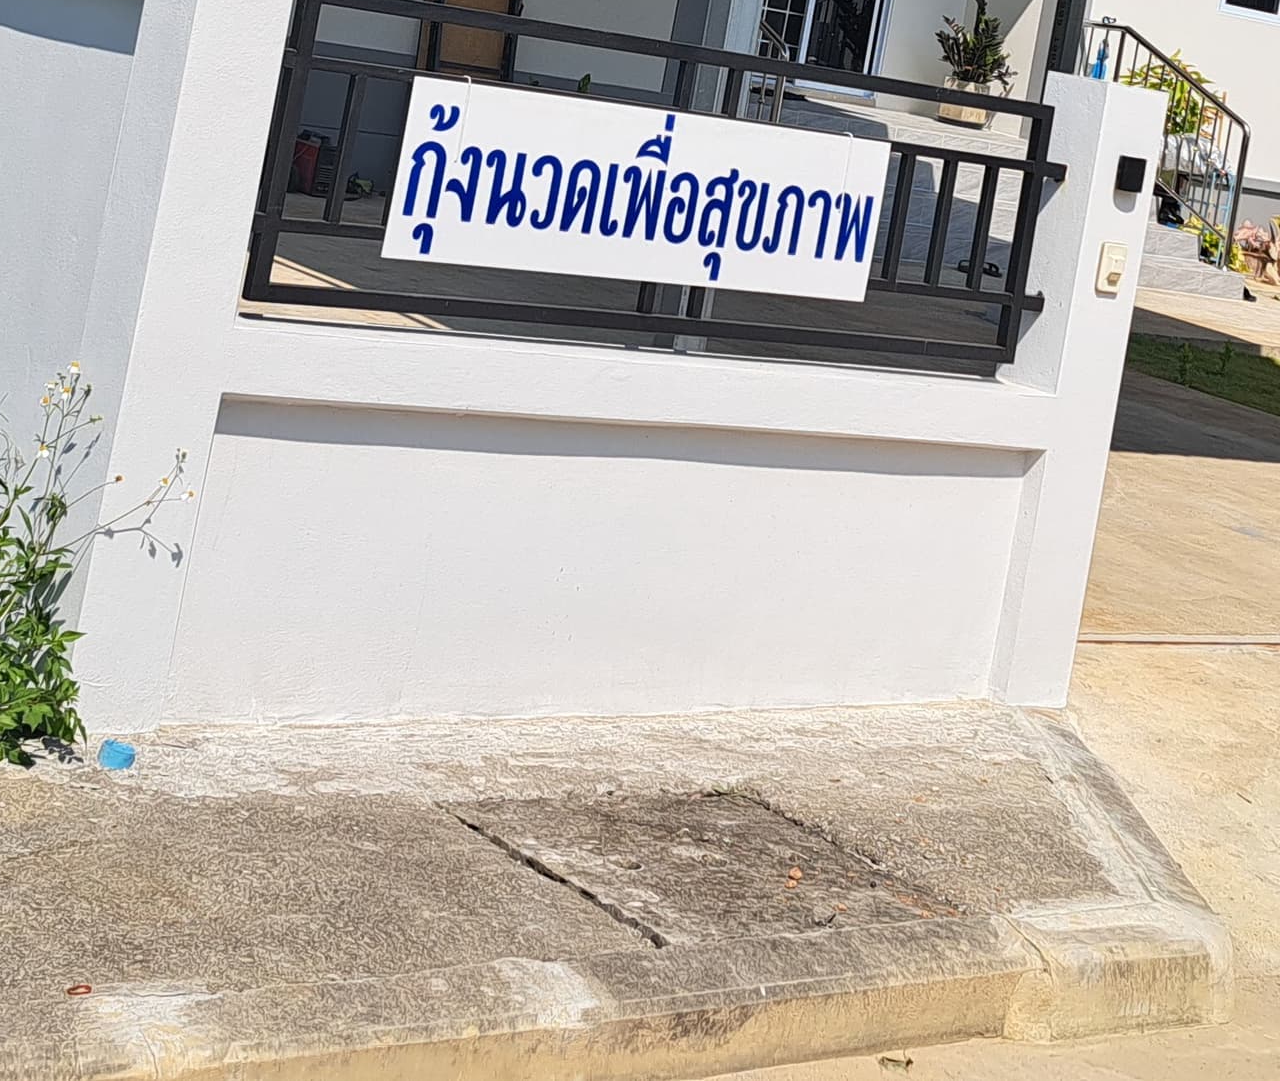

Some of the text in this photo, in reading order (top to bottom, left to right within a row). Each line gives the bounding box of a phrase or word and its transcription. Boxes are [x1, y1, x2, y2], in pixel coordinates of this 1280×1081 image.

[402, 104, 874, 281] กุ้งนวดเพื่อสุขภาพ
